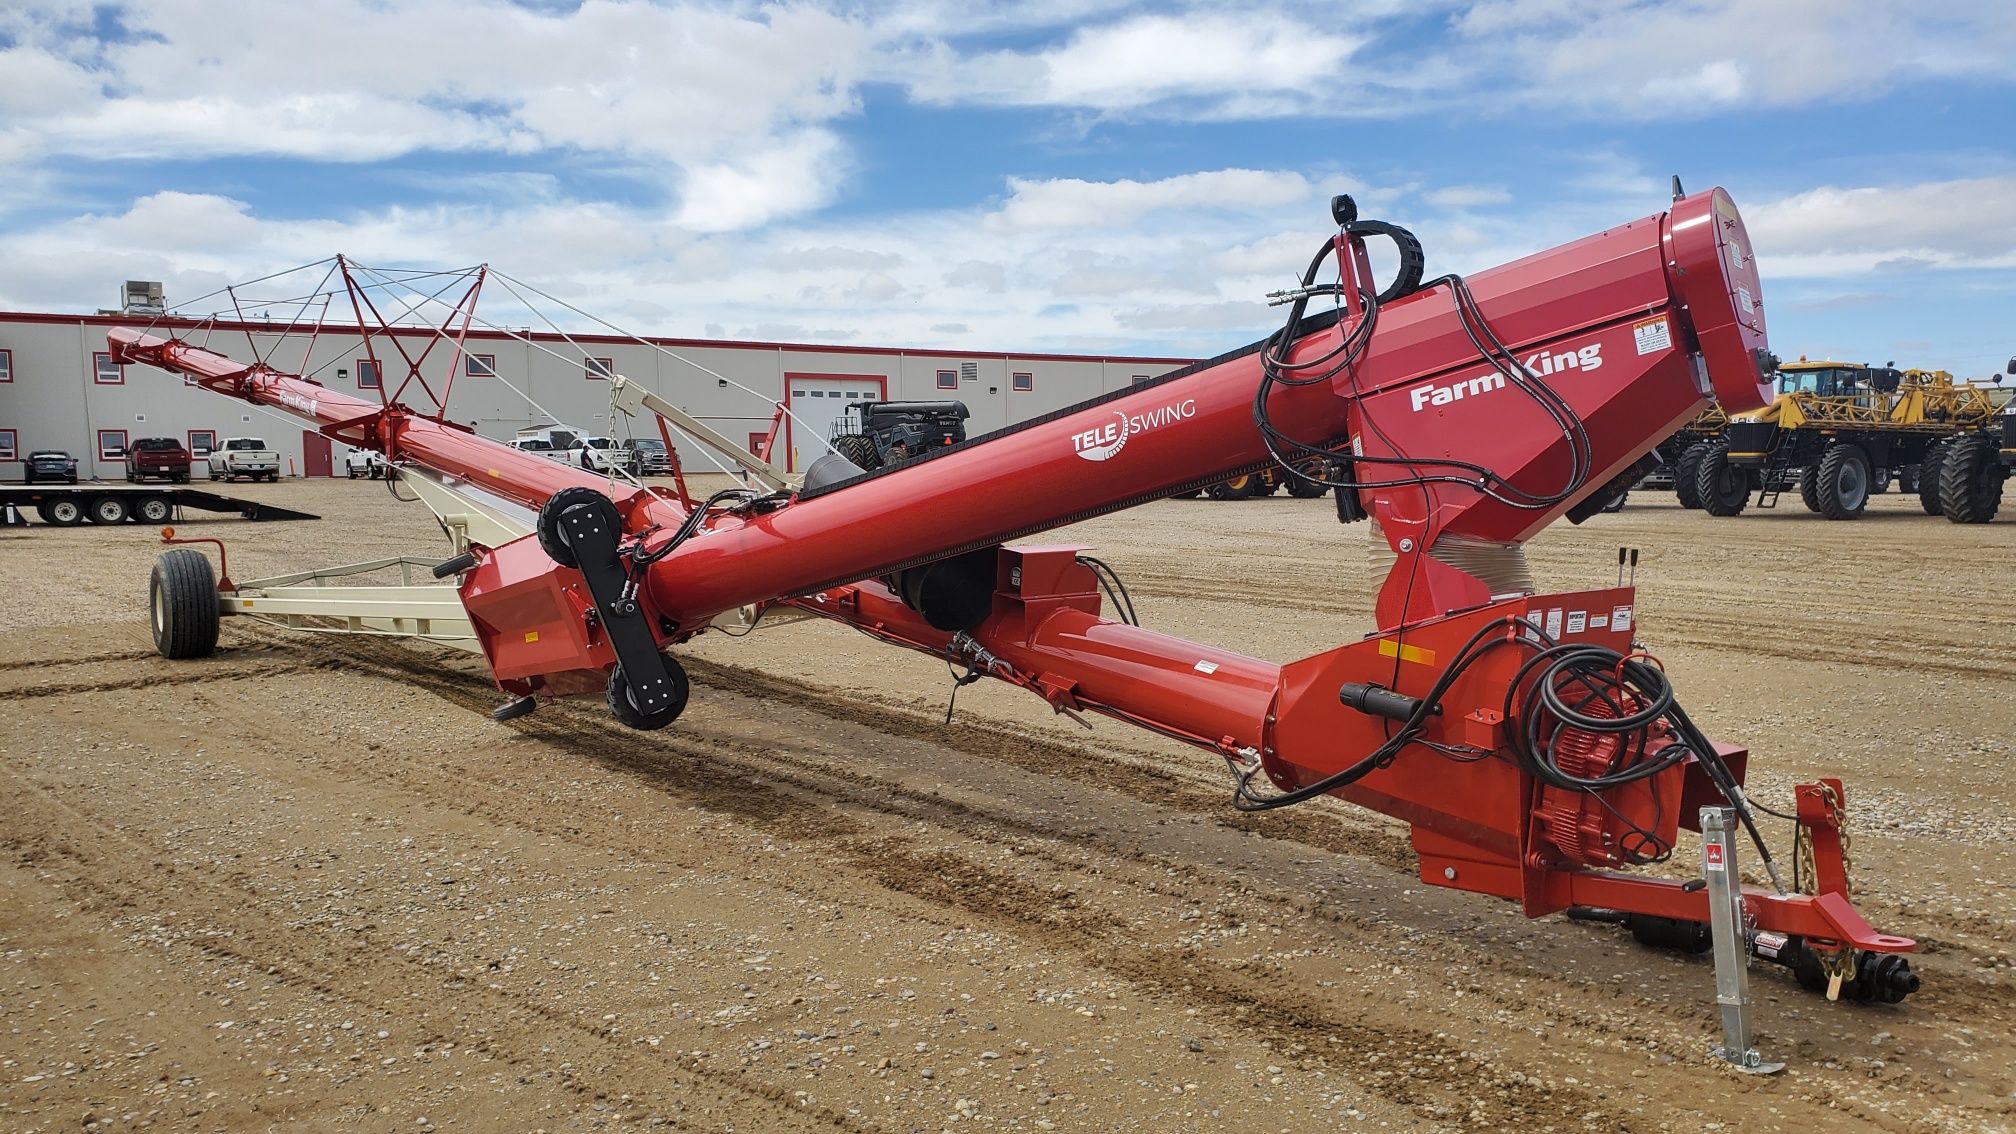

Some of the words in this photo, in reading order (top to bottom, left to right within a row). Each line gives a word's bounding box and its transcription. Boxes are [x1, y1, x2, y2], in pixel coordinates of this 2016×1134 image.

[280, 390, 296, 407] Farm
[295, 394, 311, 416] King
[1410, 371, 1506, 412] Farm
[1509, 343, 1603, 382] King
[1071, 422, 1118, 452] TELE
[1129, 399, 1196, 434] SWING
